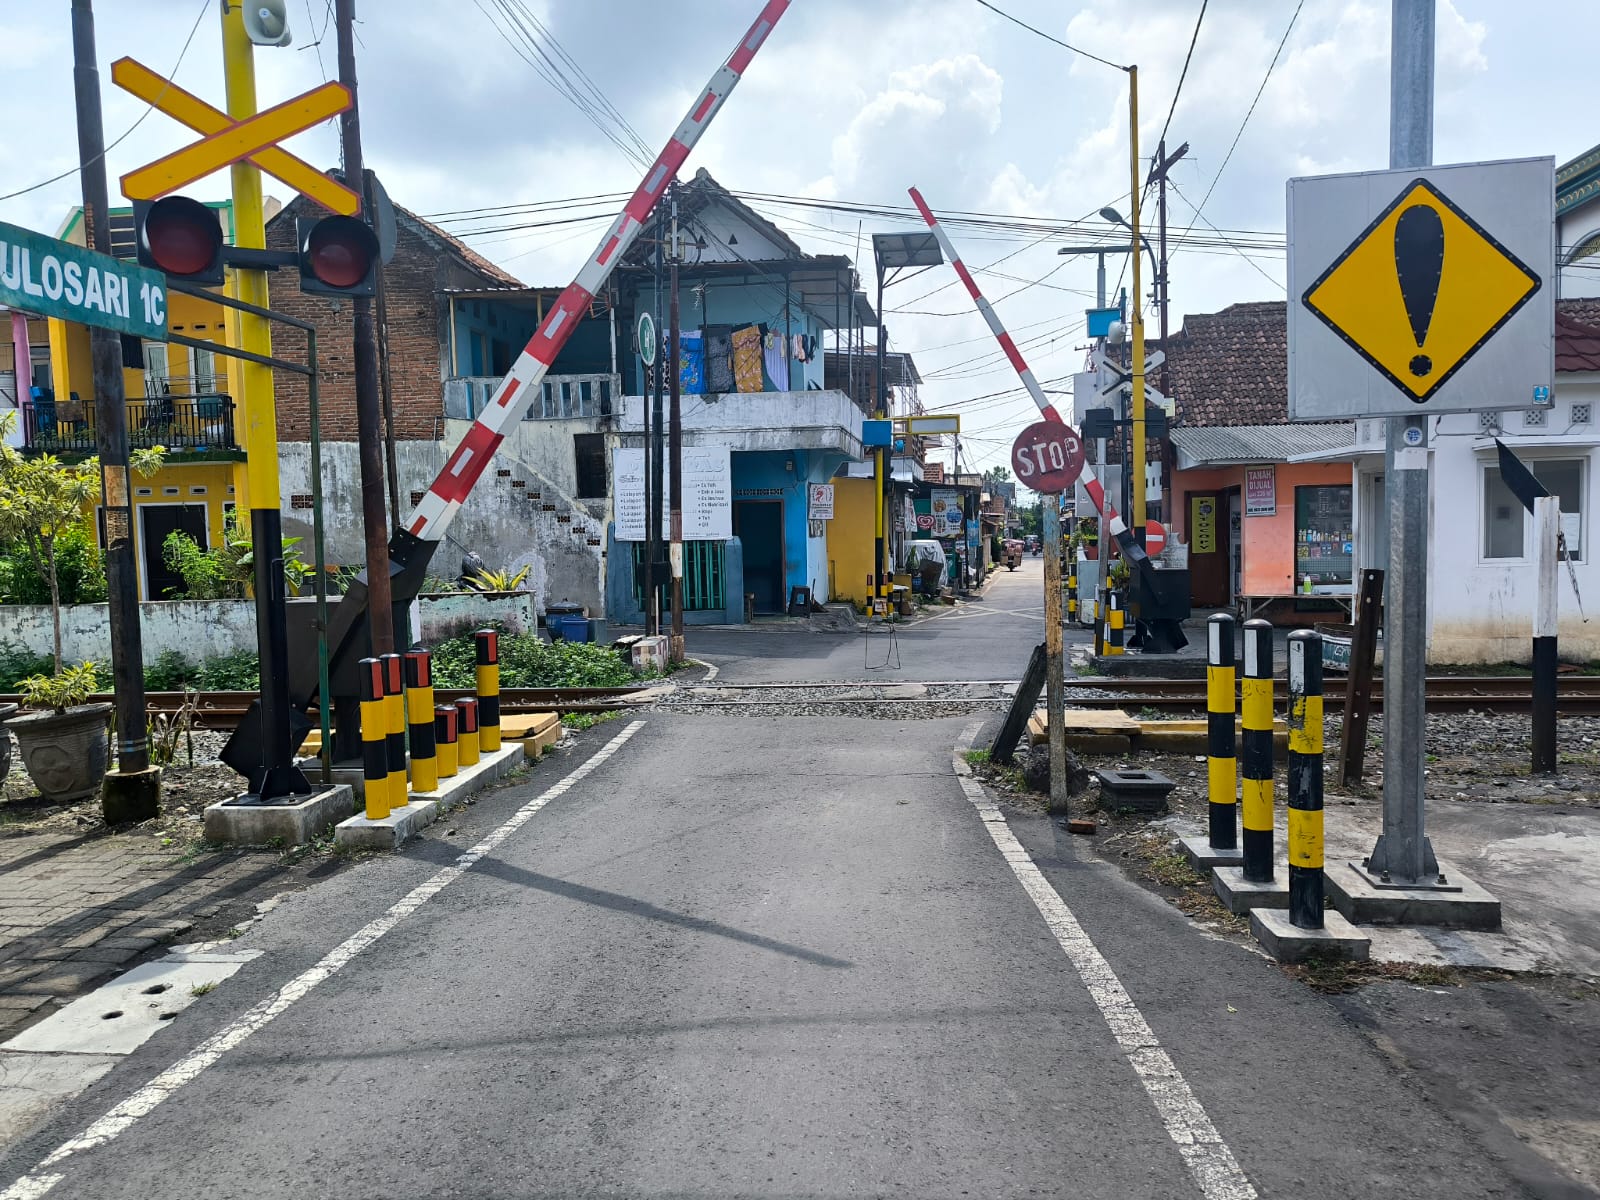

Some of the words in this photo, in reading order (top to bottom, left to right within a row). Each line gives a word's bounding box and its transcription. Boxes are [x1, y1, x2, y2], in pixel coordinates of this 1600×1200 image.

[140, 282, 165, 326] 1C
[1016, 436, 1079, 477] STOP
[1249, 470, 1272, 480] TANAH
[1249, 480, 1272, 490] DIJUAL
